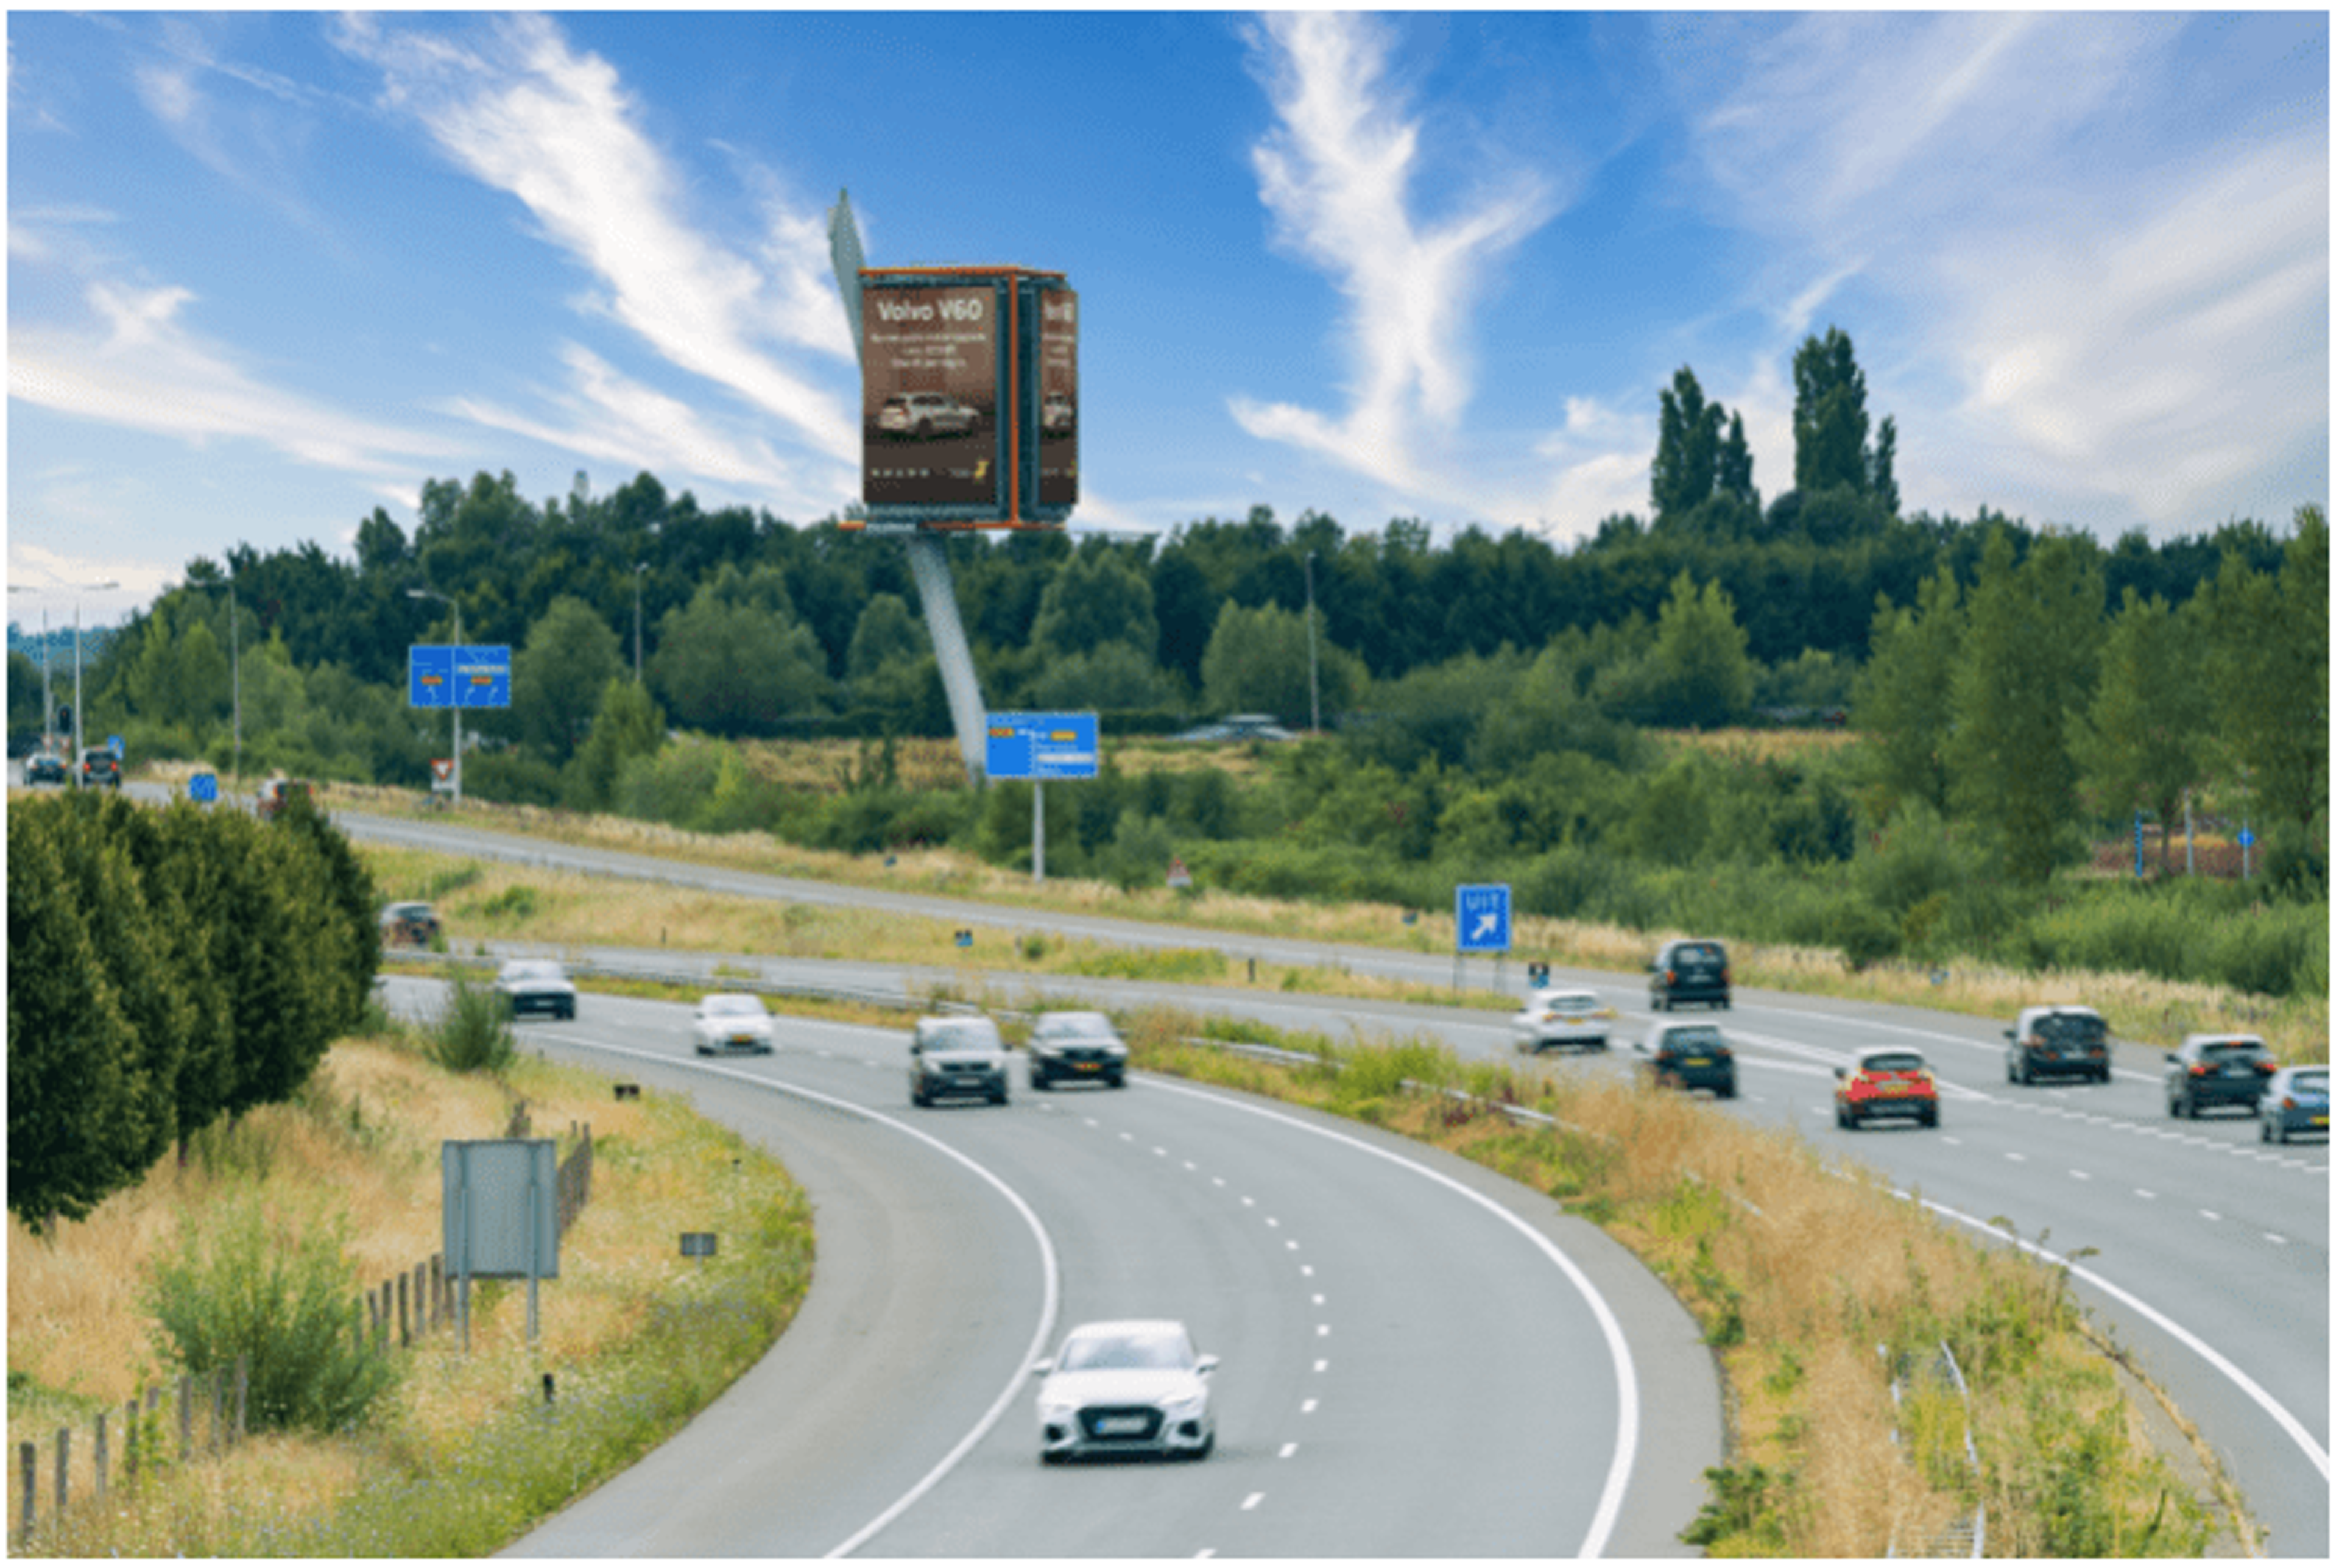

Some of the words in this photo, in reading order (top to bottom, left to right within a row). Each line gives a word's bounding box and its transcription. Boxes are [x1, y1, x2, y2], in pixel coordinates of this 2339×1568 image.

[877, 299, 933, 321] Volvo
[937, 298, 983, 321] V60
[1466, 892, 1500, 910] UIT
